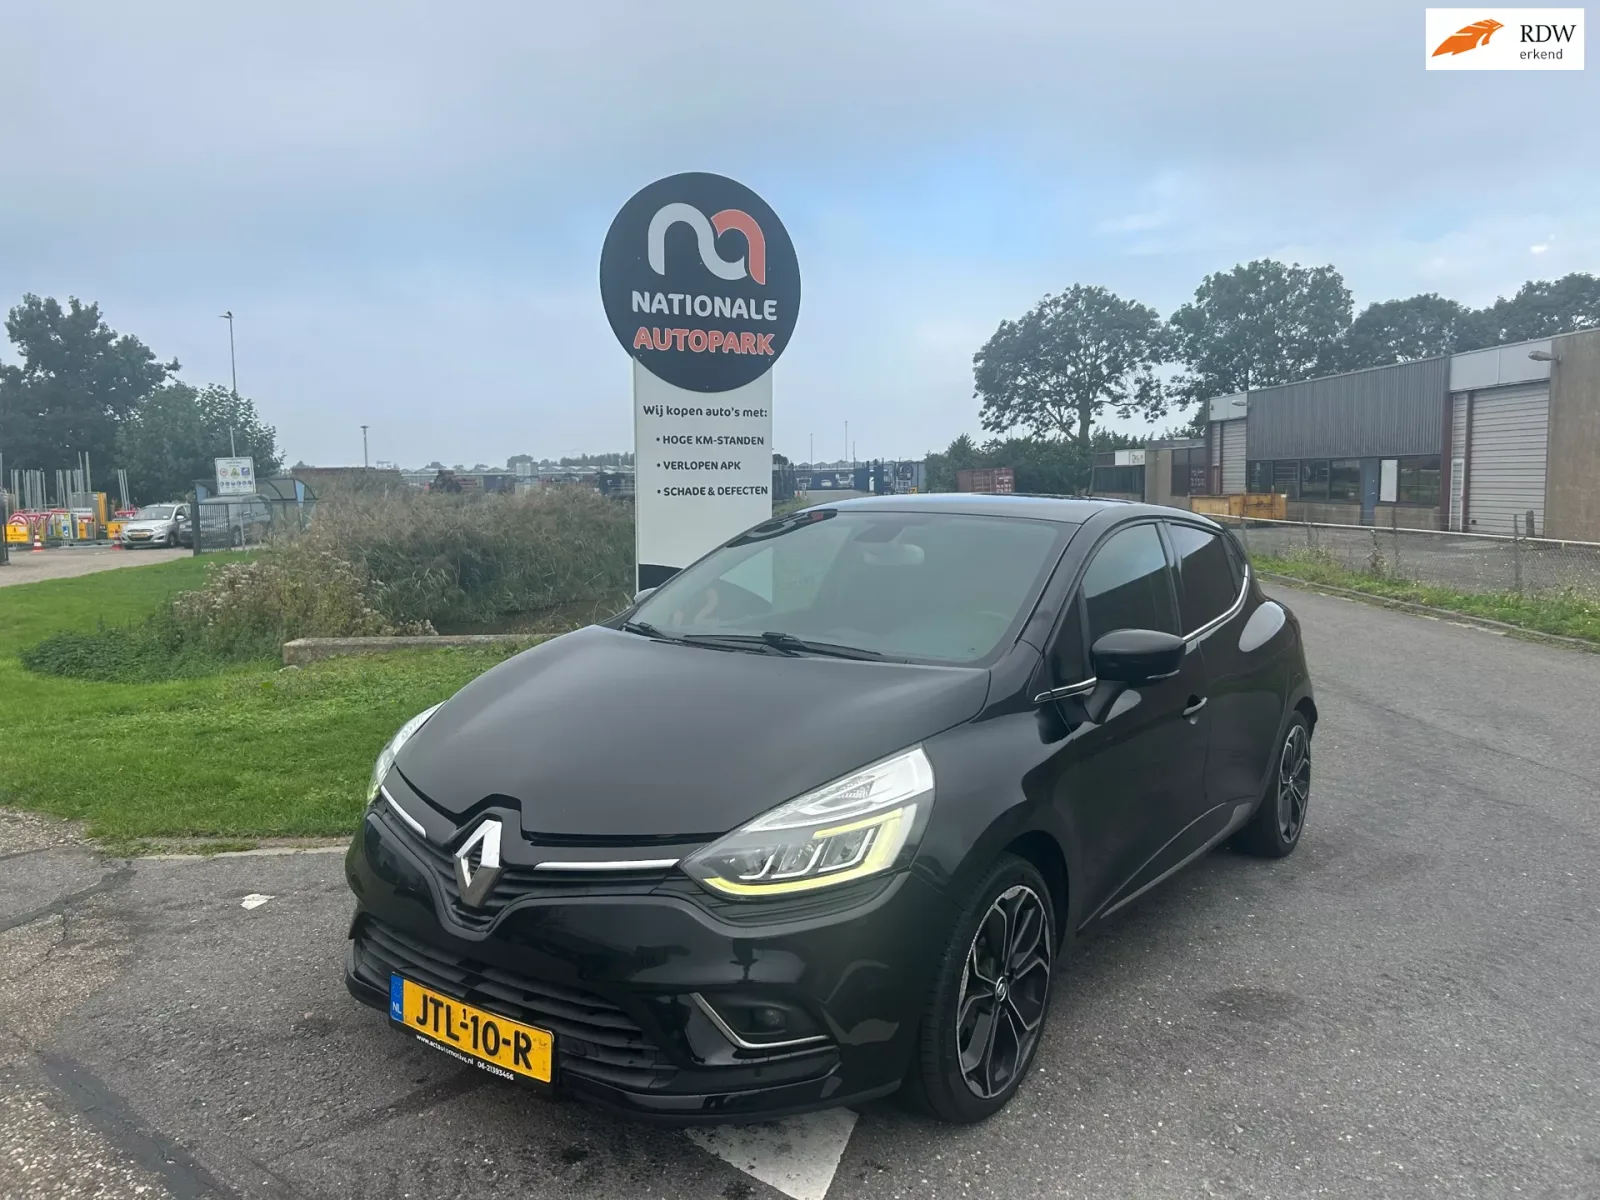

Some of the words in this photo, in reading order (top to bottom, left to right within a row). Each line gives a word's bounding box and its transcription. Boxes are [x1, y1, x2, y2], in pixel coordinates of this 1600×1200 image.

[632, 290, 777, 320] NATIONALE
[633, 326, 775, 355] AUTOPARK
[643, 405, 663, 417] Wij
[666, 405, 703, 417] kopen
[706, 407, 740, 417] auto's
[743, 408, 768, 417] met:
[663, 436, 693, 445] HOGE
[695, 436, 764, 445] KM-STANDEN
[663, 461, 718, 470] VERLOPEN
[720, 461, 742, 470] APK
[664, 487, 706, 496] SCHADE
[708, 487, 716, 496] &
[717, 486, 768, 496] DEFECTEN
[392, 1001, 402, 1014] NL
[416, 993, 532, 1070] JTL-10-R
